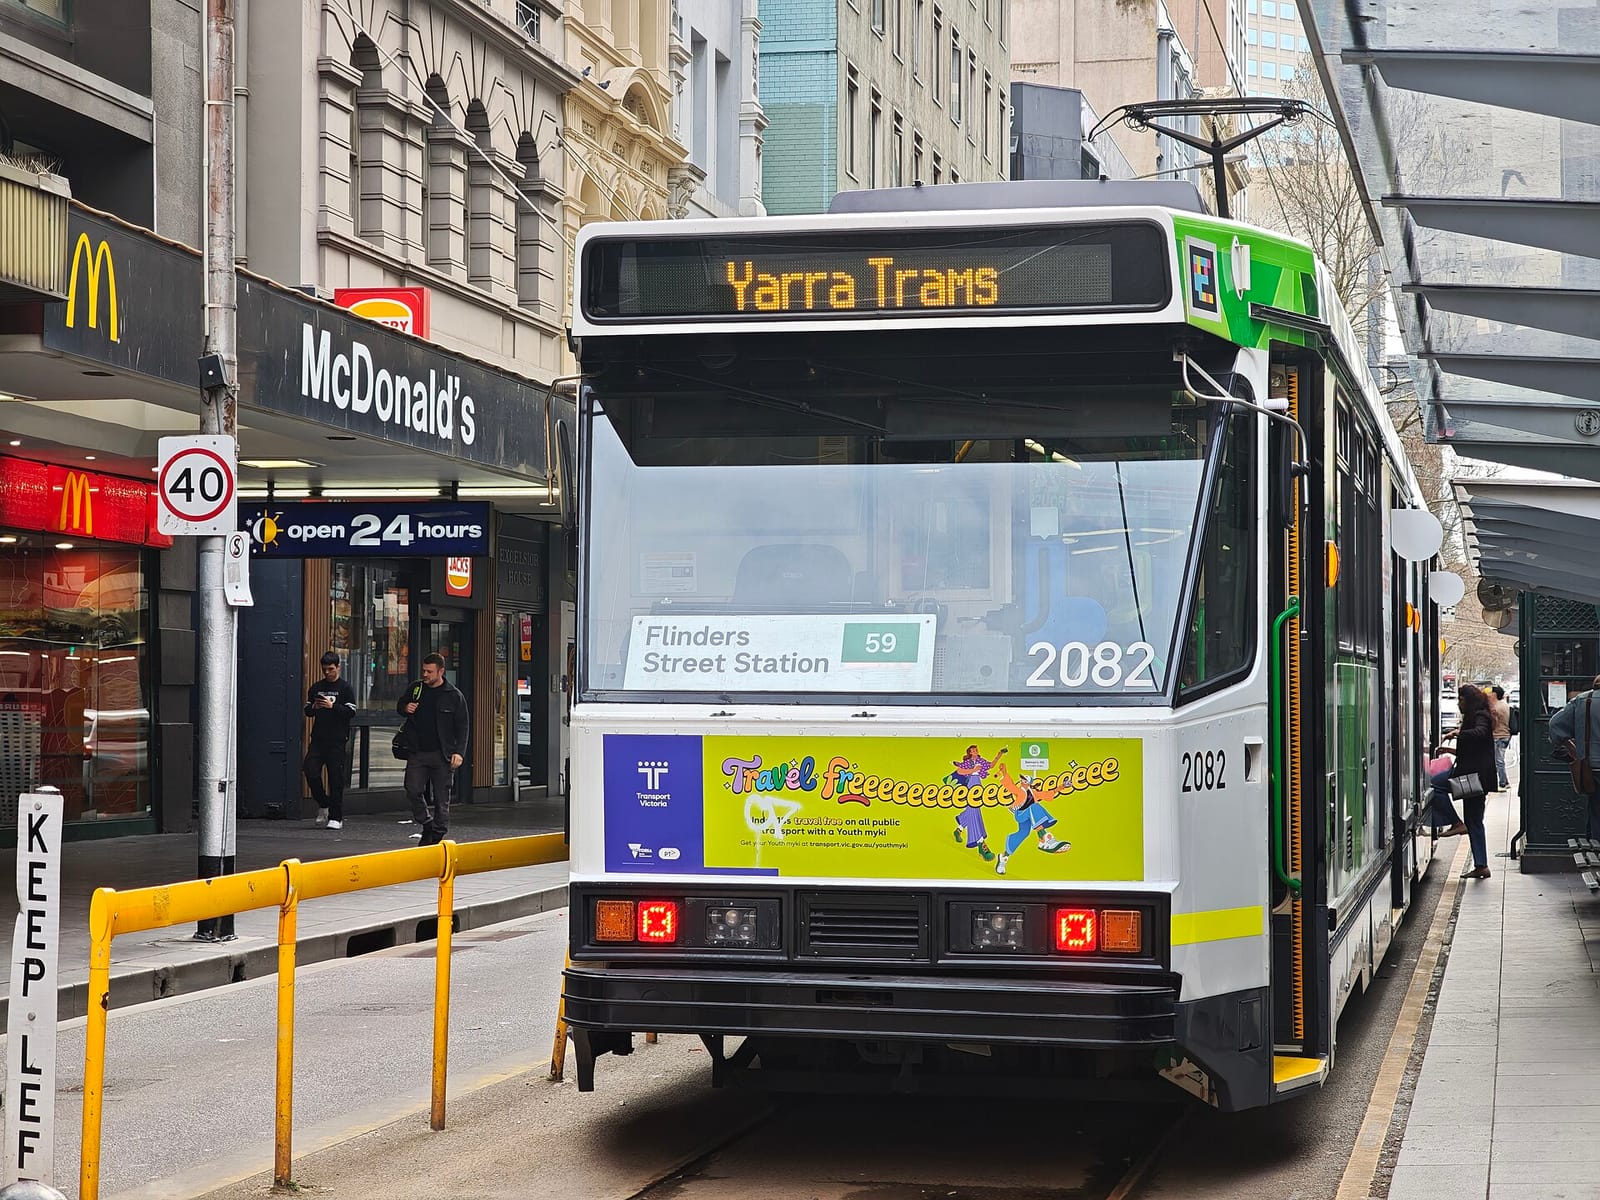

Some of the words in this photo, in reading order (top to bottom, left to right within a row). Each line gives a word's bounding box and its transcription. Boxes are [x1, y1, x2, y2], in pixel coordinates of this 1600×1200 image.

[727, 261, 855, 311] Yarra
[868, 257, 998, 308] Trams
[301, 322, 476, 445] McDonald's
[168, 466, 224, 503] 40
[287, 524, 345, 542] open
[349, 514, 415, 546] 24
[417, 521, 483, 539] hours
[645, 625, 751, 647] Flinders
[864, 632, 898, 654] 59
[642, 652, 726, 674] Street
[733, 651, 830, 674] Station
[1025, 640, 1156, 688] 2082
[722, 755, 817, 794] Travel
[1181, 749, 1226, 793] 2082
[636, 792, 671, 802] Transport
[640, 800, 668, 808] Victoria
[761, 827, 805, 837] rasport
[807, 827, 826, 836] with
[836, 828, 863, 837] Youth
[864, 828, 887, 839] myki
[794, 816, 822, 825] travel
[823, 816, 843, 825] free
[845, 818, 857, 826] on
[858, 816, 871, 826] all
[872, 817, 901, 829] public
[740, 839, 752, 847] Get
[752, 840, 766, 848] yur
[787, 840, 801, 848] myki
[809, 840, 909, 849] transport.vic.gov.au/youthmyki
[22, 812, 49, 998] KEEP
[17, 1033, 43, 1182] LEF
